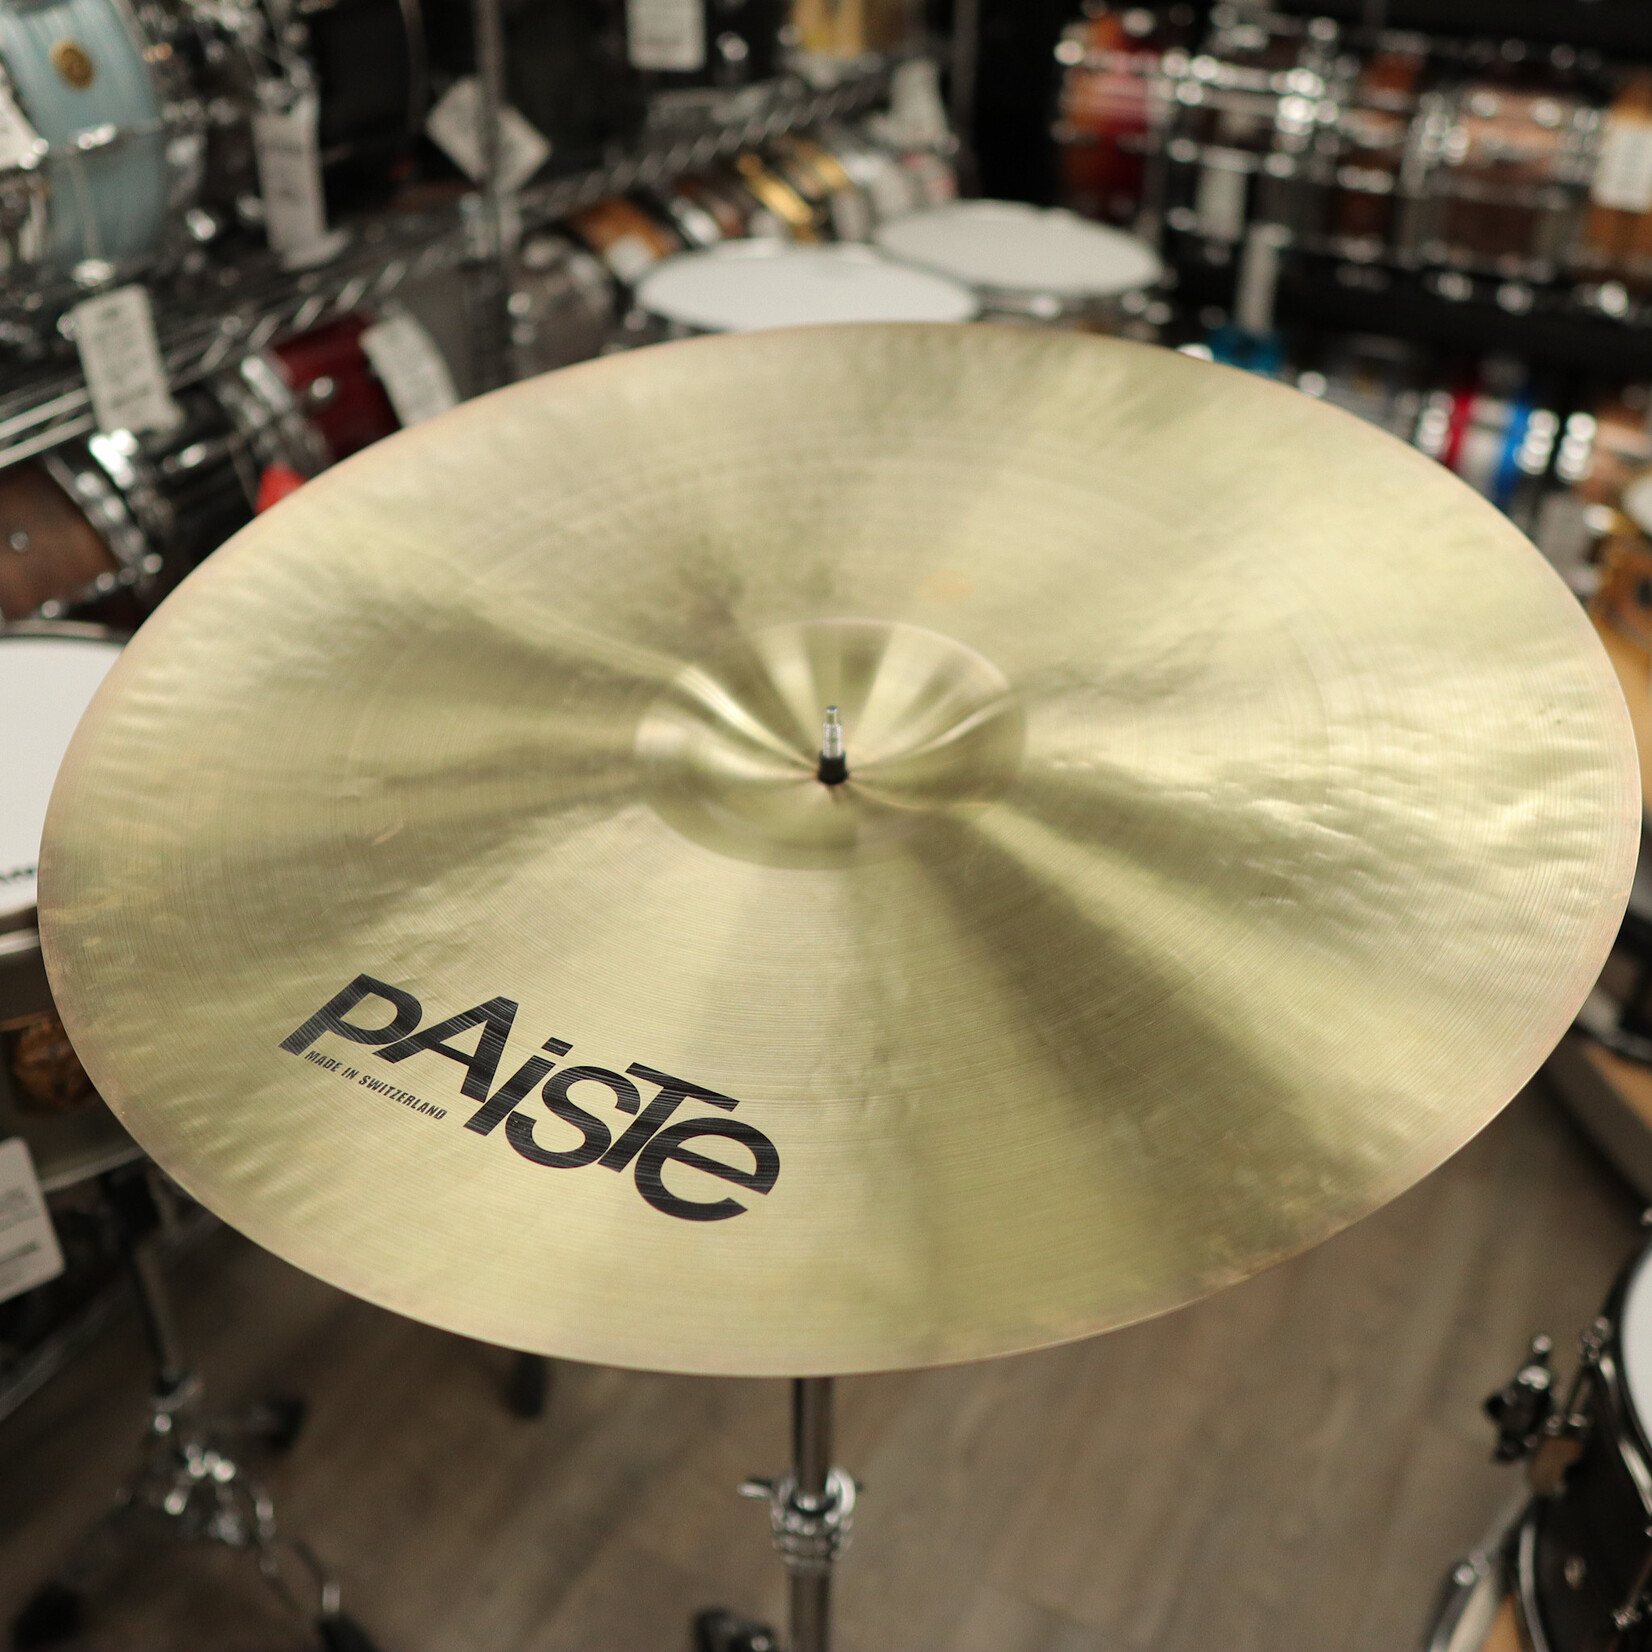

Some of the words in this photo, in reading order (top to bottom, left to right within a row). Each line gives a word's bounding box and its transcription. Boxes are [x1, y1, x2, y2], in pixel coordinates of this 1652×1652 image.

[304, 1050, 343, 1072] MADE
[341, 1067, 360, 1080] IN
[358, 1075, 448, 1120] SWITZERLAND
